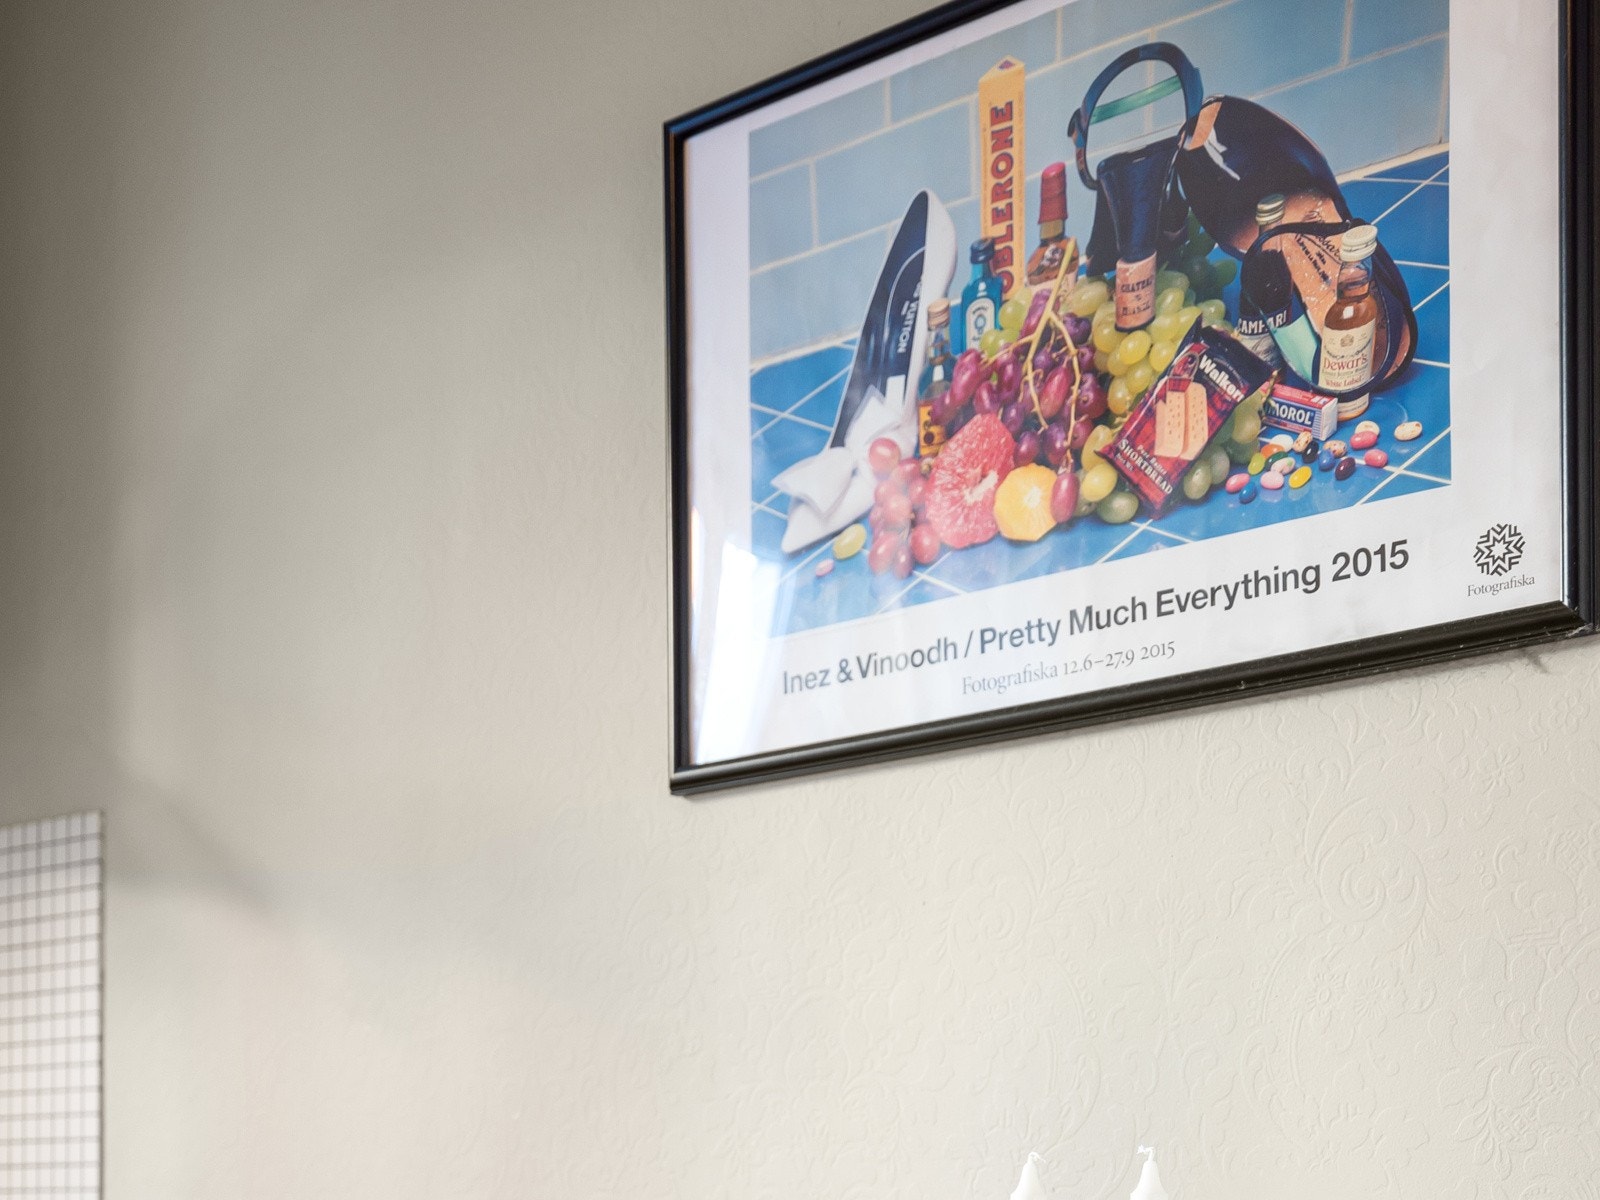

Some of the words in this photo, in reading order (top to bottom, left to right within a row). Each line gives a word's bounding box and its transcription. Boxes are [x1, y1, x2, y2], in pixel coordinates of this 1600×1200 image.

[990, 100, 1014, 295] OBLERONE
[783, 669, 831, 695] Inez
[837, 659, 853, 683] &
[856, 637, 958, 679] Vinoodh
[980, 617, 1061, 654] Pretty
[1069, 596, 1147, 635] Much
[1156, 564, 1321, 618] Everything
[1331, 539, 1410, 582] 2015
[1467, 574, 1535, 596] Fotografiska
[962, 662, 1058, 695] Fotografiska
[1141, 641, 1175, 660] 2015
